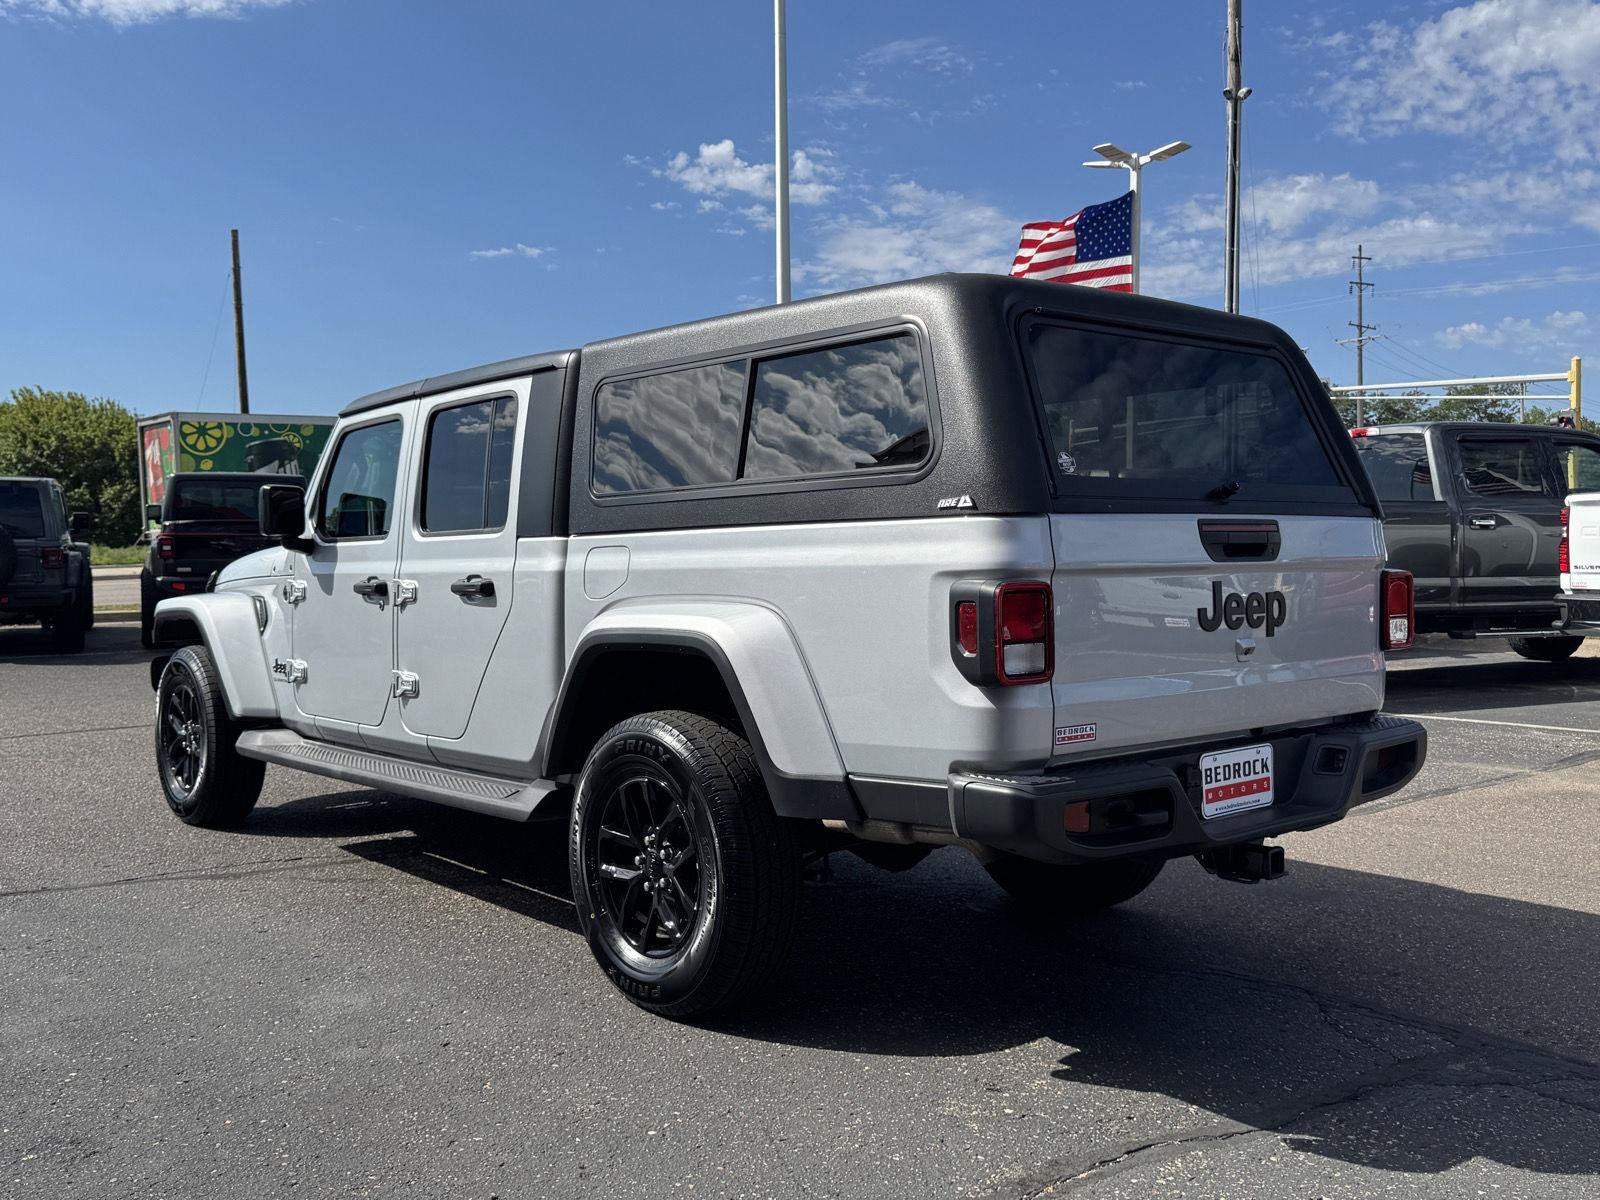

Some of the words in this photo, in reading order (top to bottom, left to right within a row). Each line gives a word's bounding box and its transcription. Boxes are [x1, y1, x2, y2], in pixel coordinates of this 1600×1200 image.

[1197, 581, 1287, 637] Jeep
[1057, 726, 1095, 736] BEDROCK
[1204, 757, 1270, 785] BEDROCK
[1208, 781, 1268, 799] MOTORS
